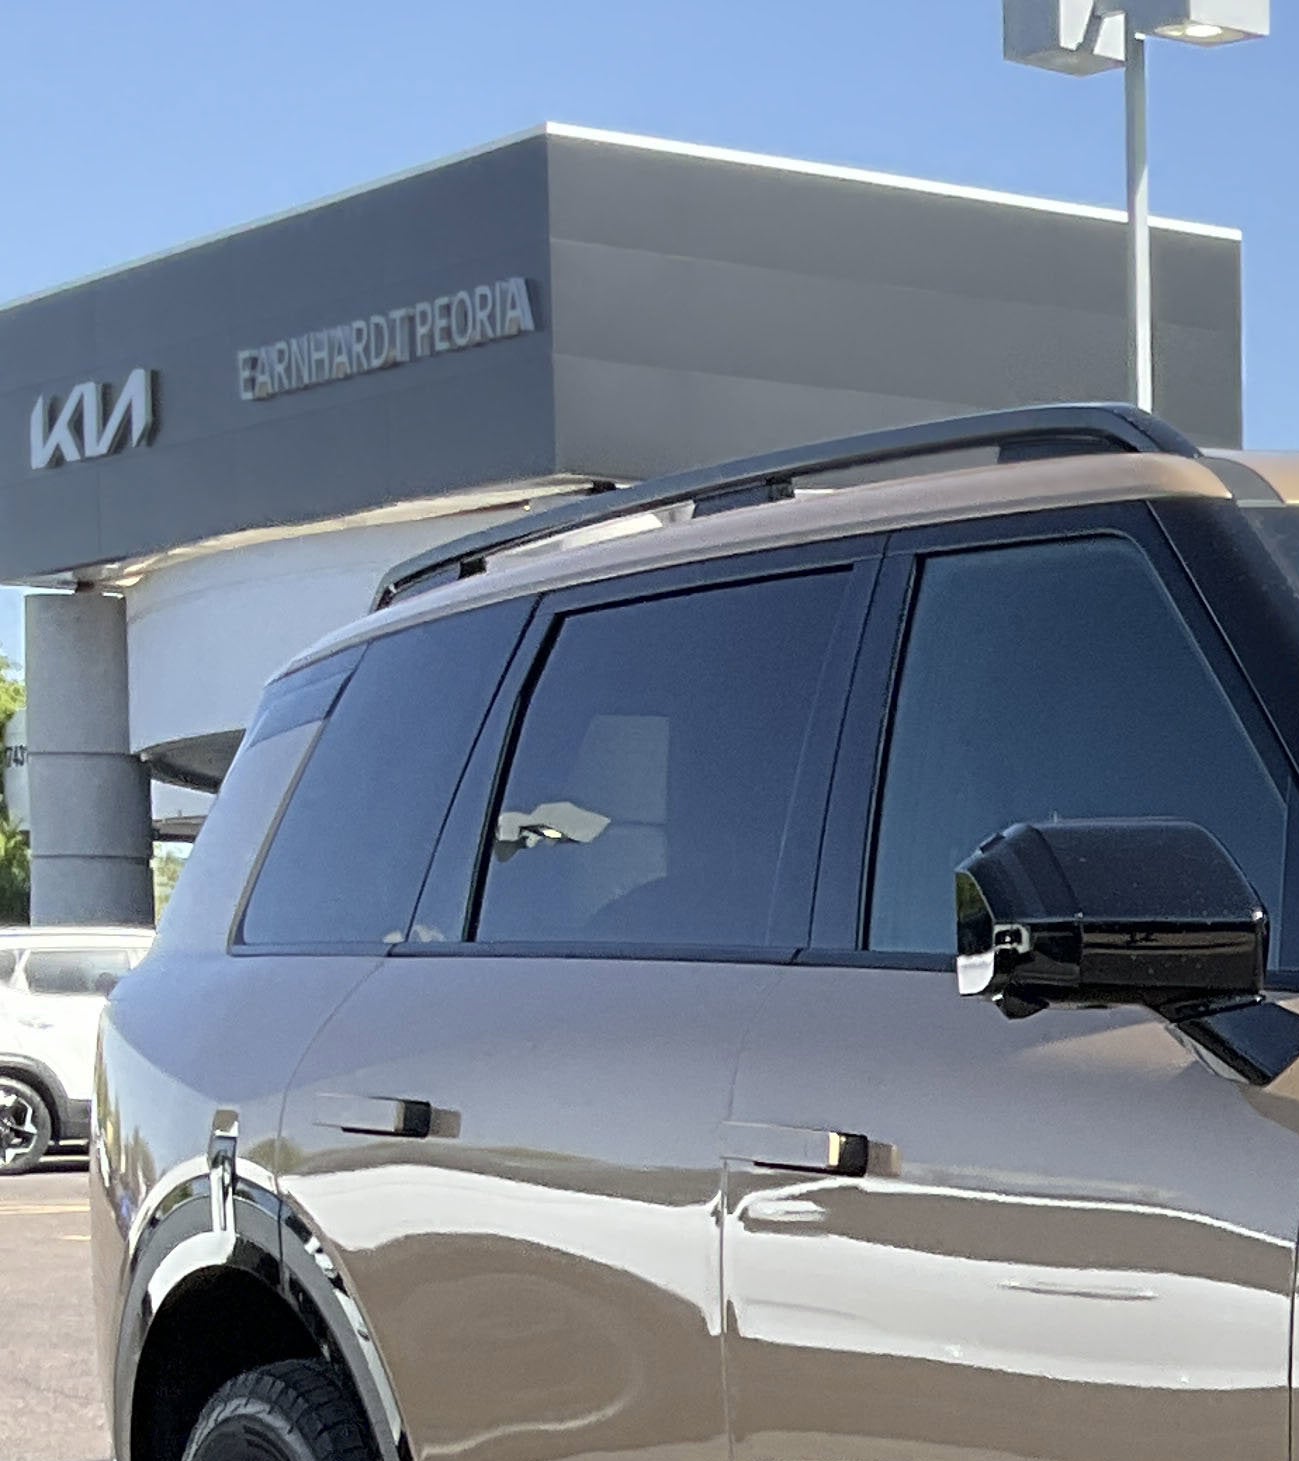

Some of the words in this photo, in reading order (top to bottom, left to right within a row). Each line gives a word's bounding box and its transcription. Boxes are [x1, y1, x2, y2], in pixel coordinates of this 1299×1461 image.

[237, 308, 412, 401] EARNHARDT
[414, 275, 534, 357] PEORIA
[29, 367, 158, 470] KIA
